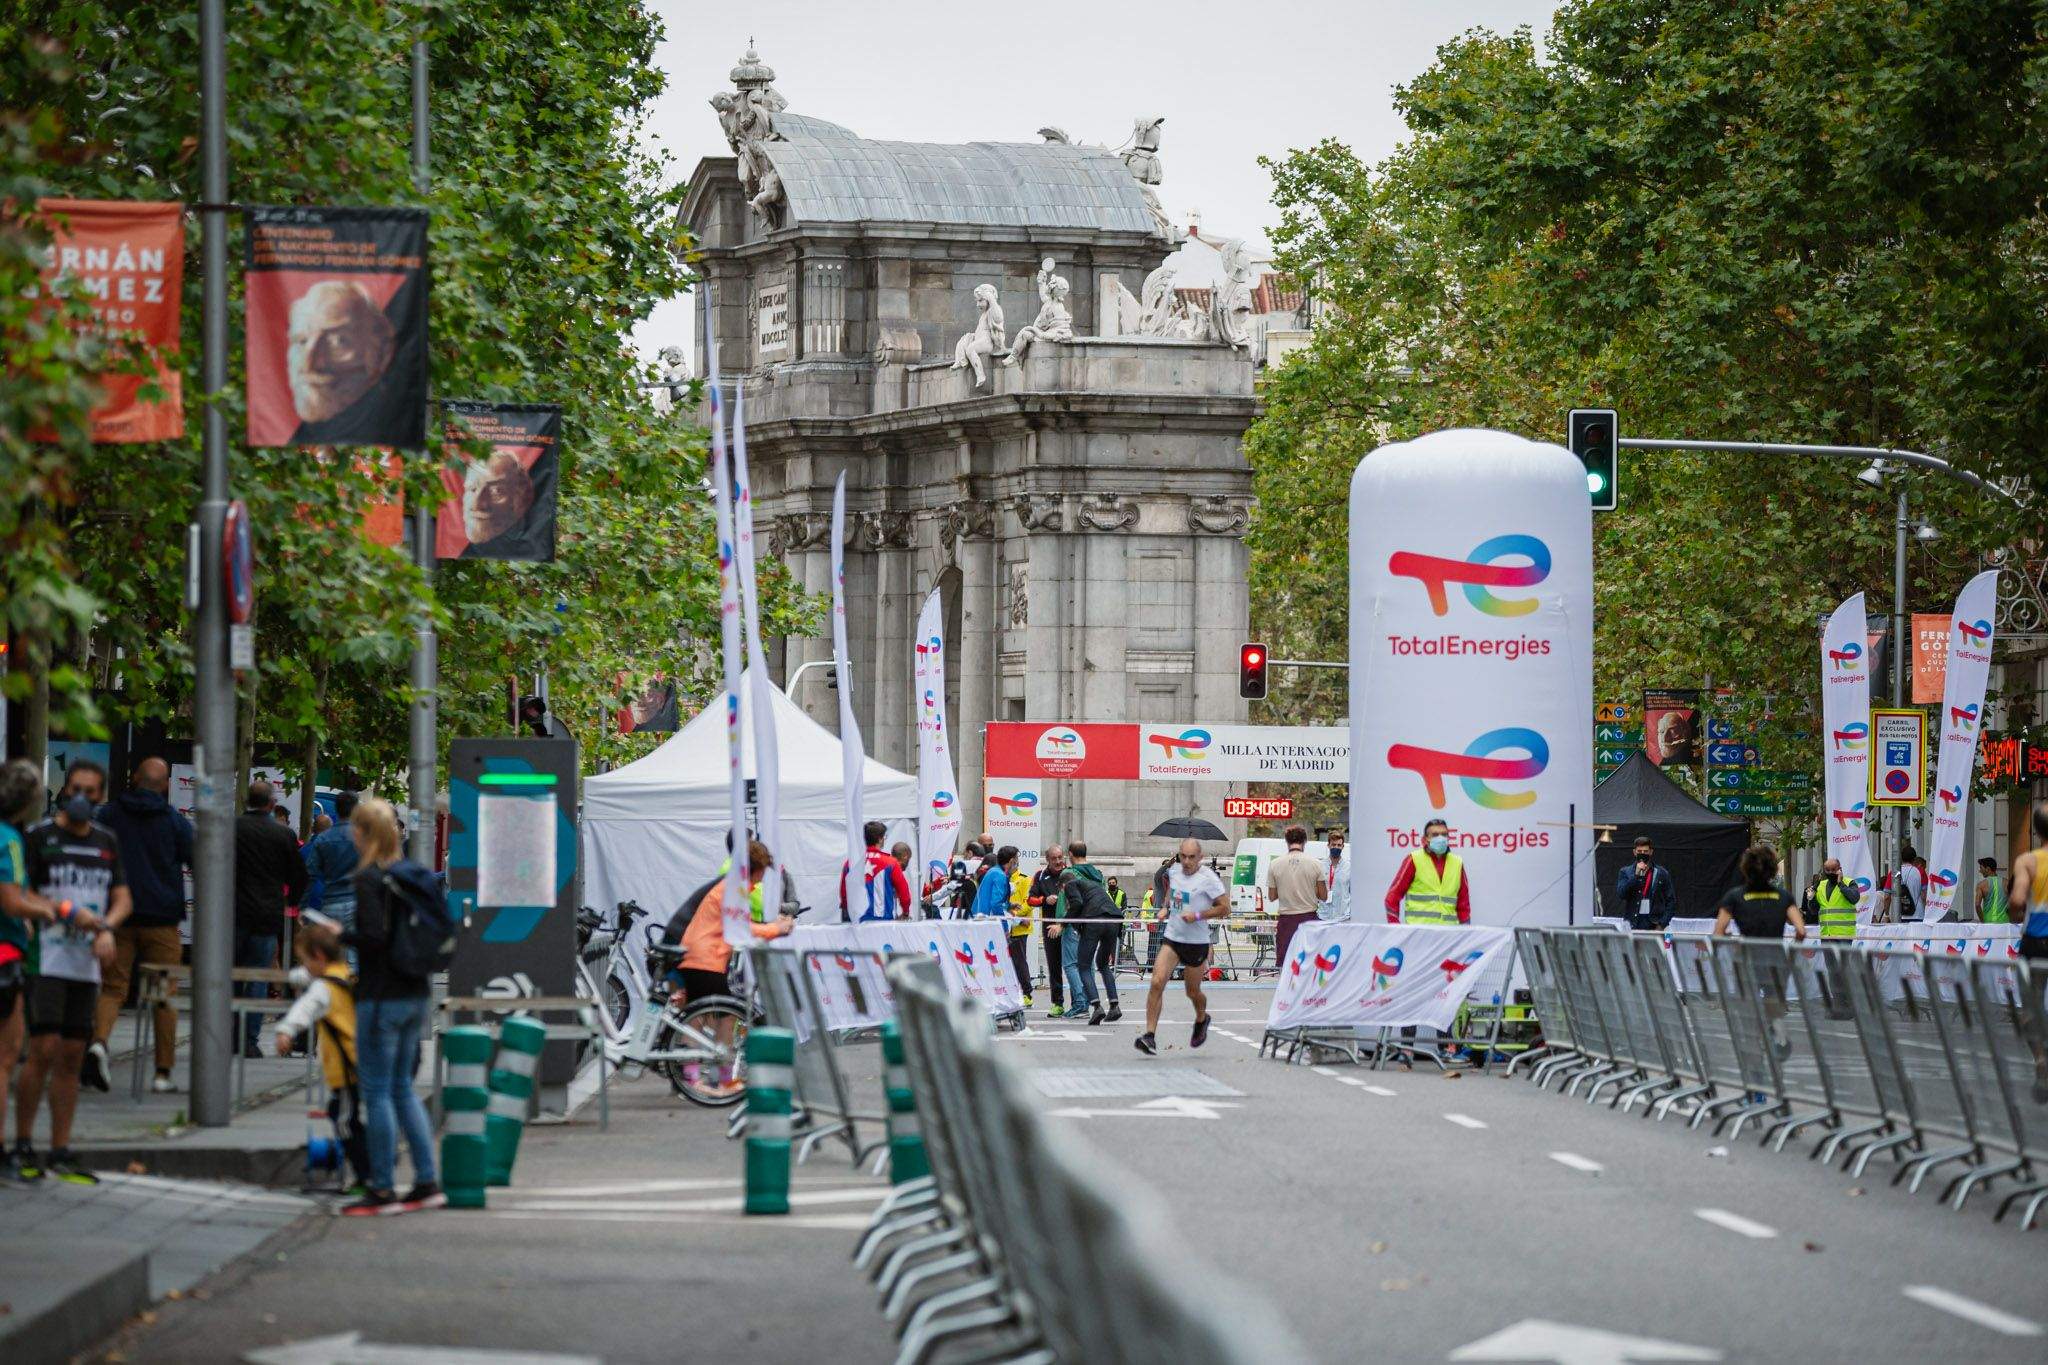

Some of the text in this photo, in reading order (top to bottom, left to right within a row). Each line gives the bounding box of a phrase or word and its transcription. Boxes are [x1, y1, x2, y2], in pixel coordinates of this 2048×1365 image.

[1388, 634, 1551, 660] TotalEnergies
[1220, 745, 1262, 755] MILLA
[1149, 765, 1212, 775] TotalEnergies
[1260, 759, 1335, 771] DE MADRID
[1744, 804, 1773, 812] Manuel
[988, 820, 1038, 829] TotalEnergies
[1386, 827, 1549, 853] TotEnergies
